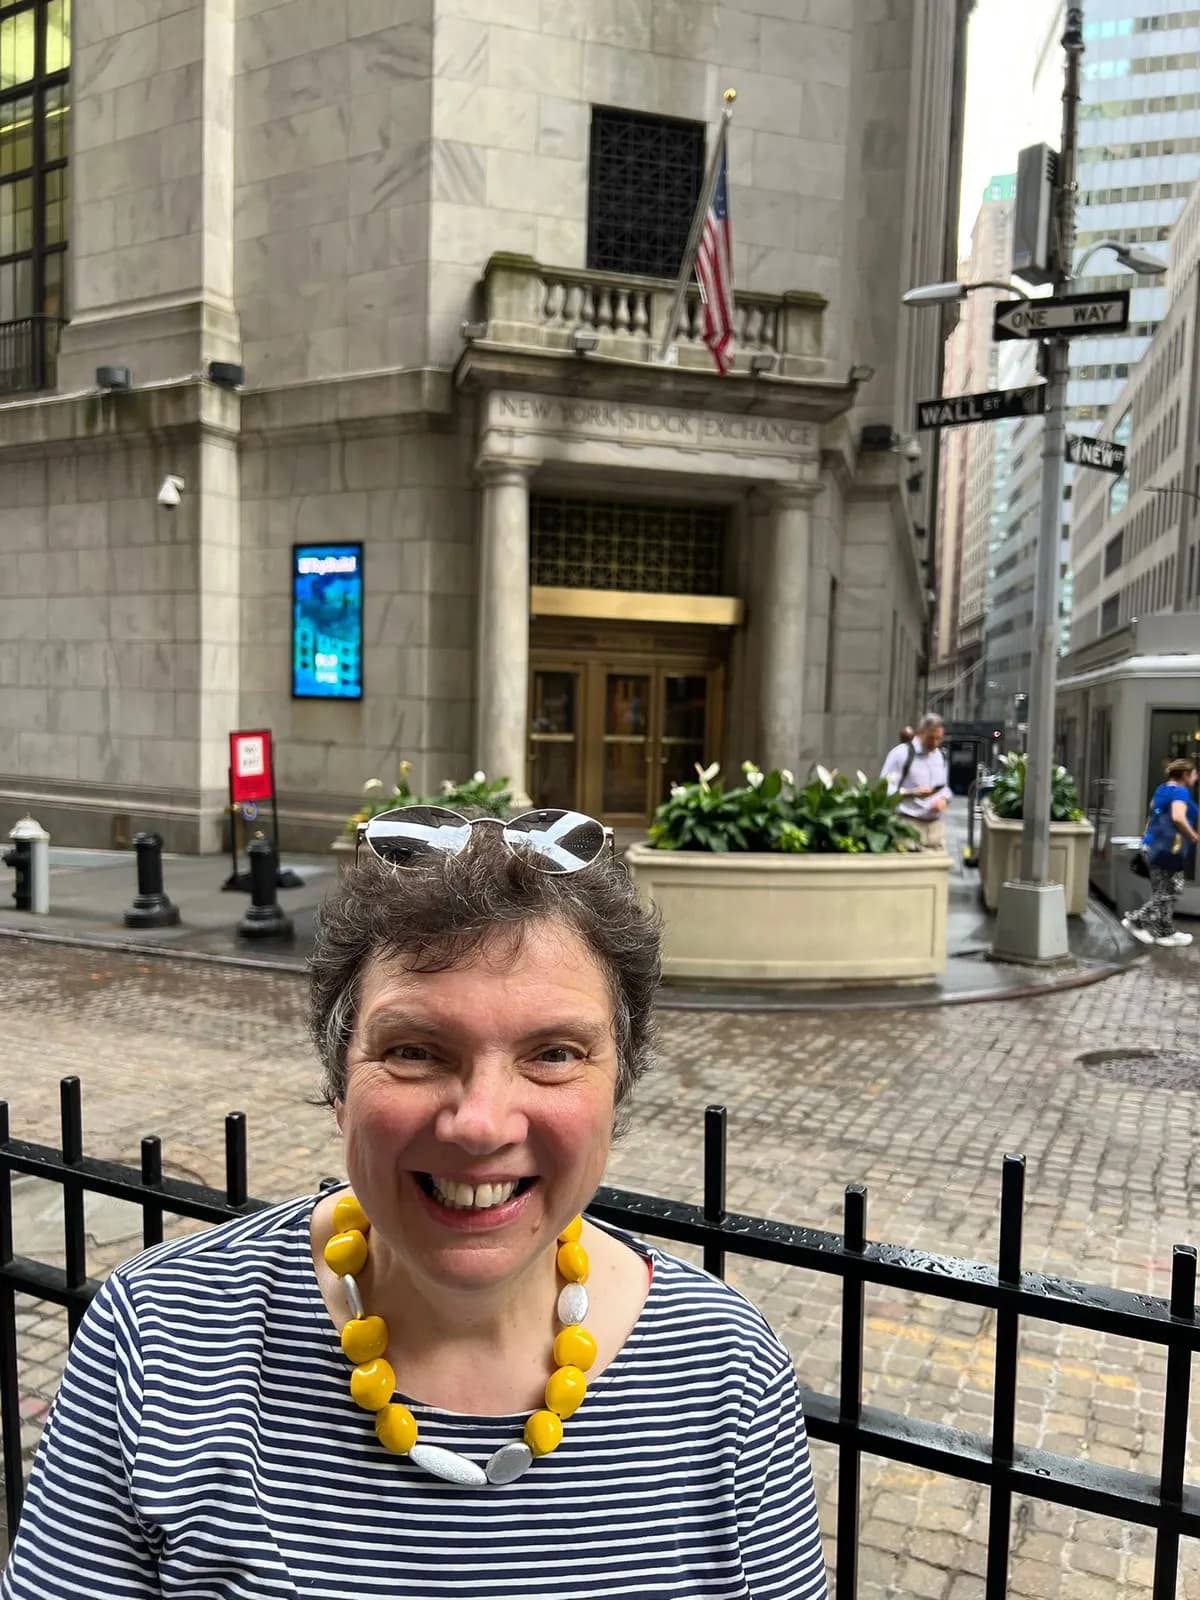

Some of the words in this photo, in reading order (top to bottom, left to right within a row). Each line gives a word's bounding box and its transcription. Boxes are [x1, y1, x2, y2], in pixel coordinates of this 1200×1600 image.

[1012, 309, 1047, 328] ONE
[1073, 304, 1113, 323] WAY
[499, 395, 548, 420] NEW
[558, 402, 616, 426] YORK
[623, 408, 692, 435] STOCK
[704, 417, 810, 446] EXCHANGE
[921, 399, 982, 425] WALL
[1081, 443, 1113, 467] NEW
